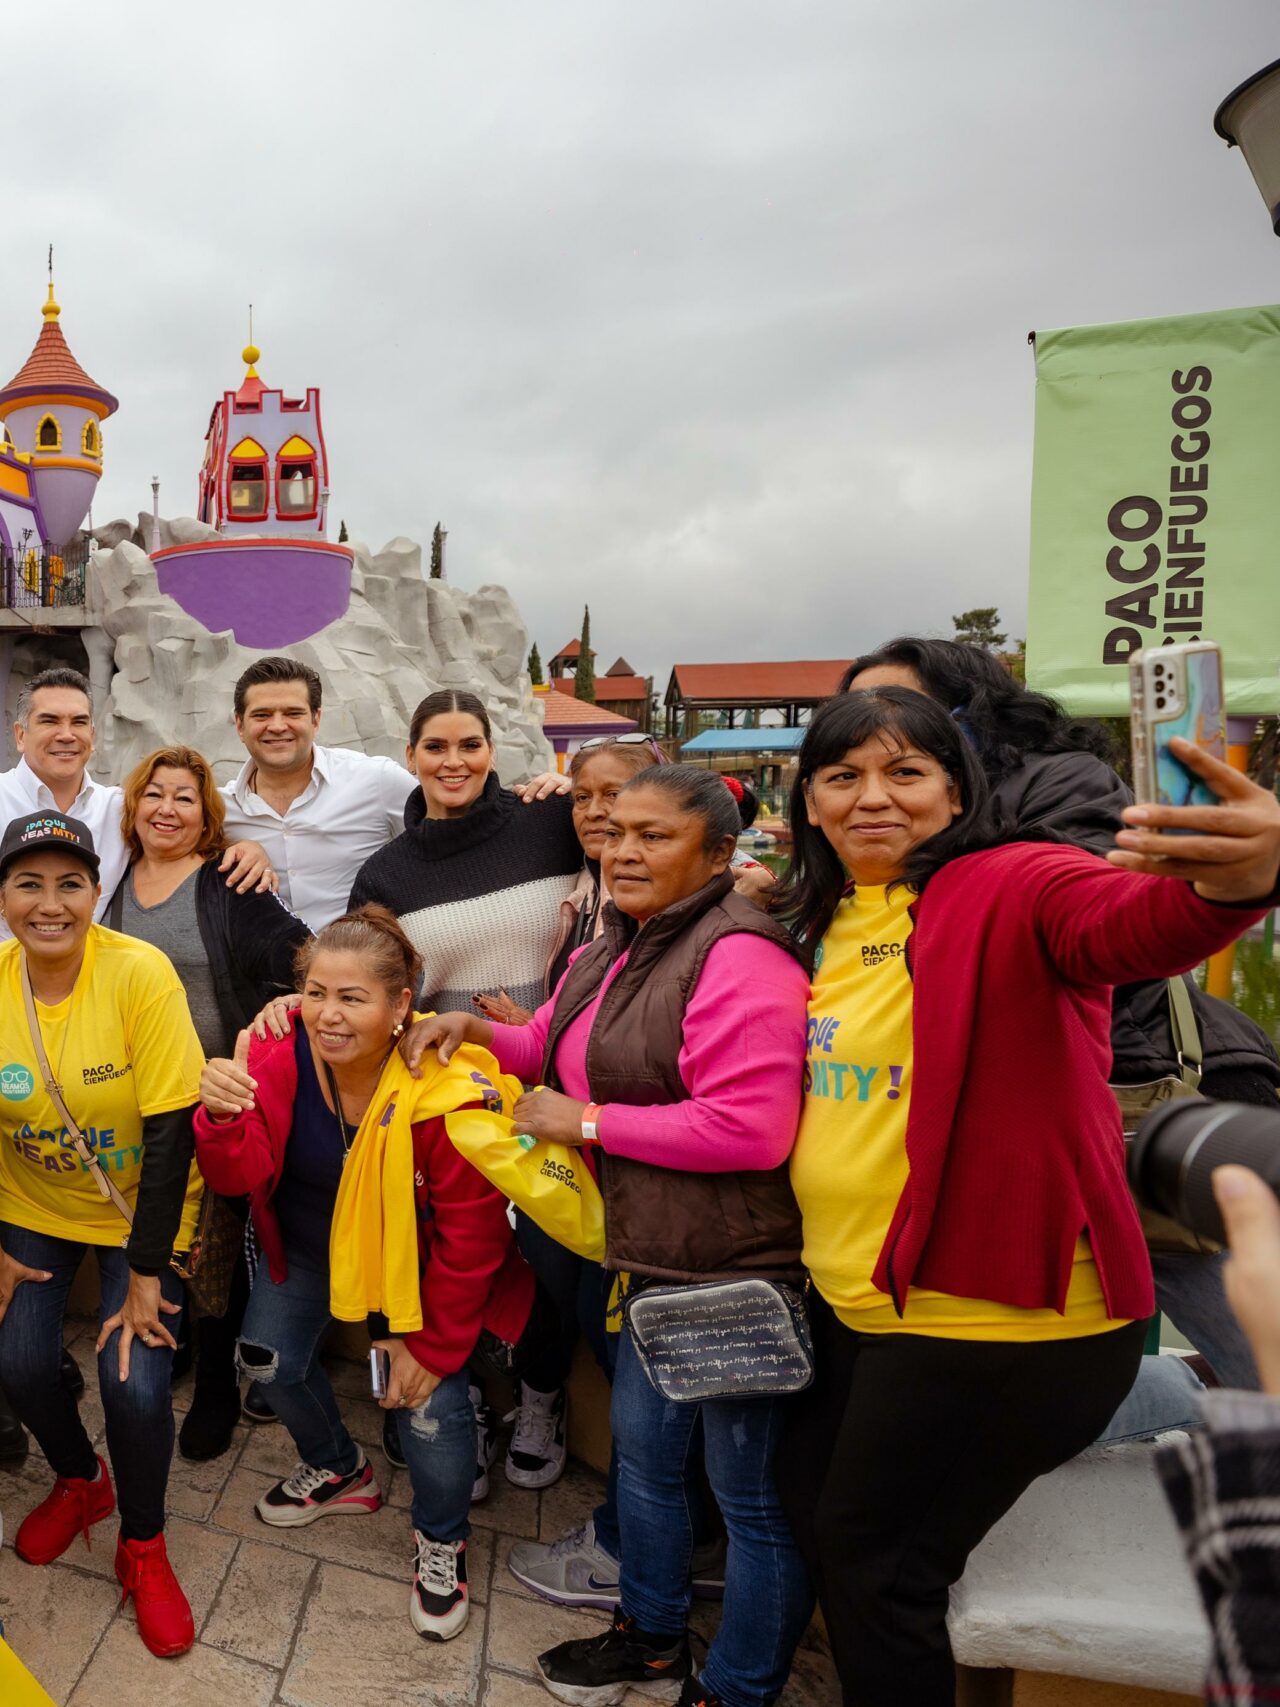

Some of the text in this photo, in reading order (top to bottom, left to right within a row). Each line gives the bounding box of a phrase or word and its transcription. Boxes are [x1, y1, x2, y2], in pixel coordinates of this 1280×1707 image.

[1103, 495, 1163, 664] PACO
[21, 827, 51, 842] VEAS
[83, 1064, 114, 1078] PACO
